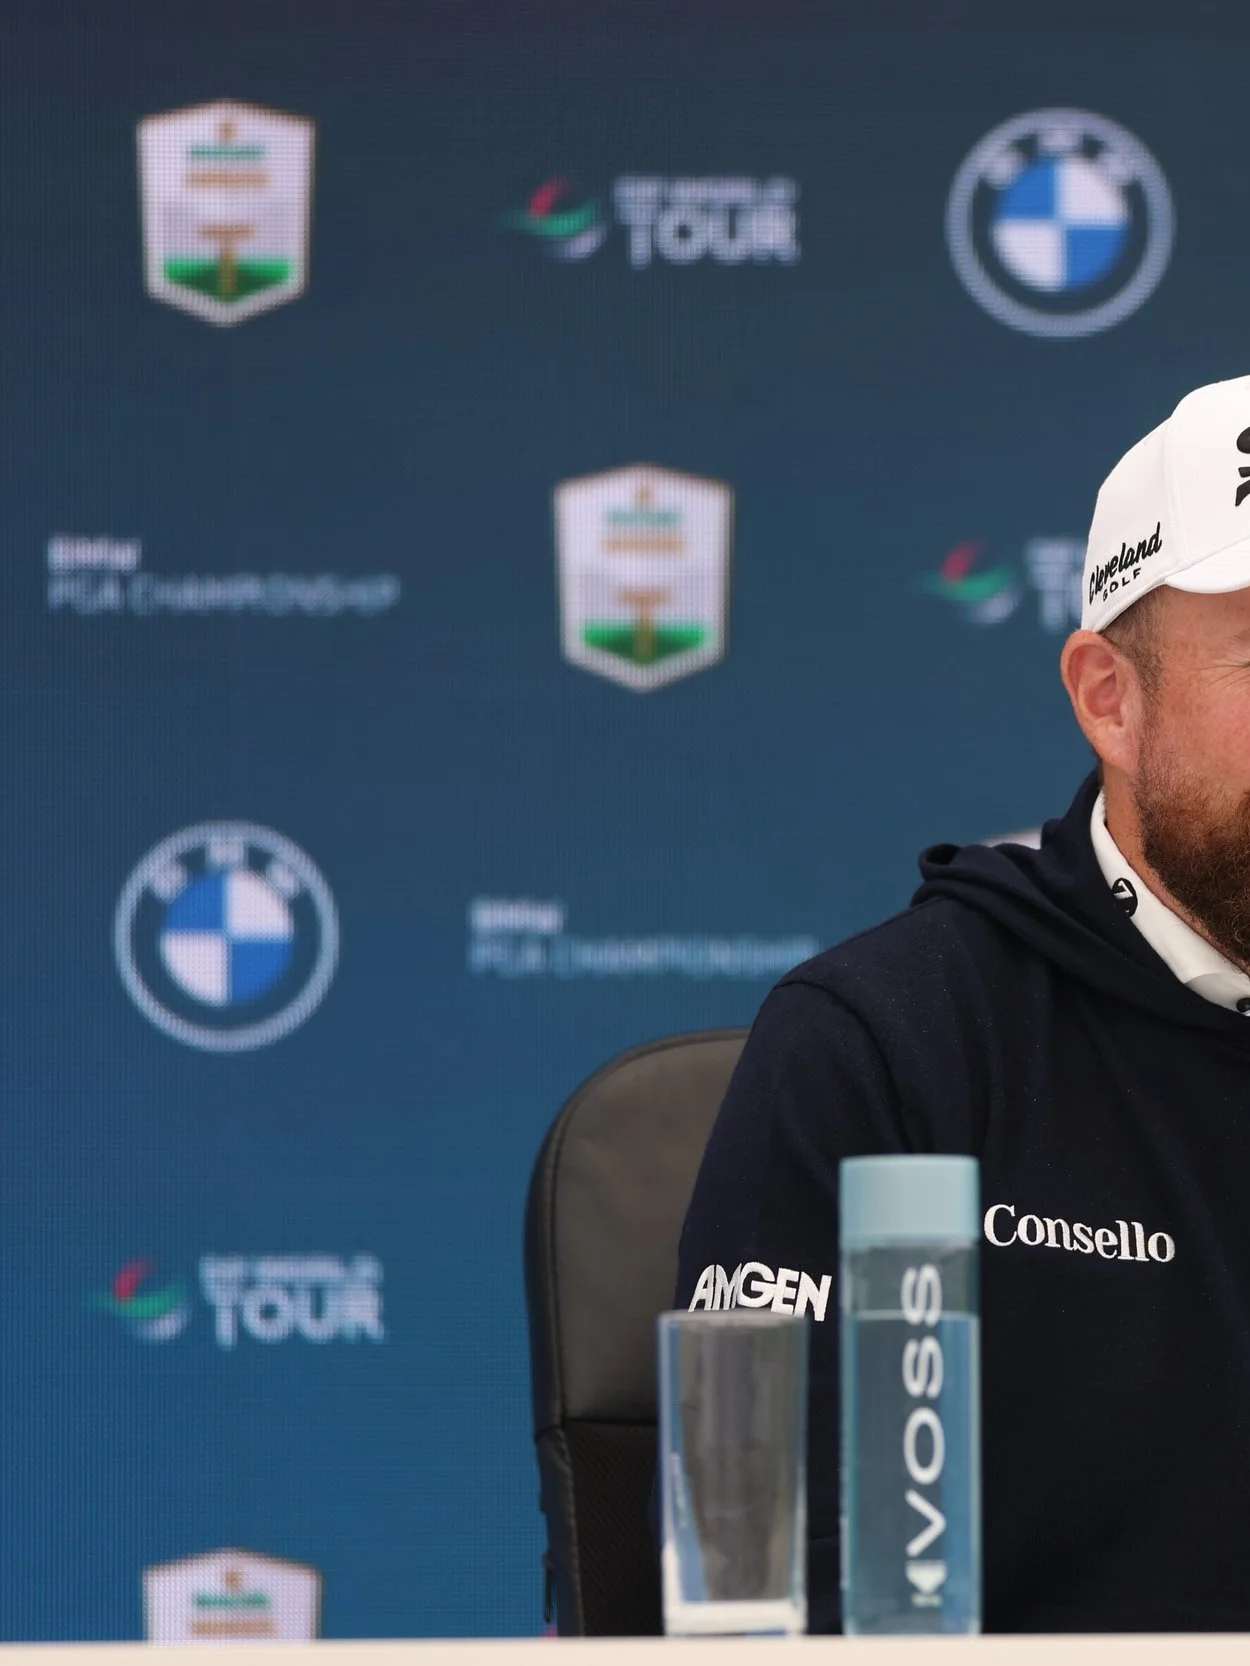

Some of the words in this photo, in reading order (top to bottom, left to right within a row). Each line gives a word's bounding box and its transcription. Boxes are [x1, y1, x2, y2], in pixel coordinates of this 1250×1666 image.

[618, 206, 800, 267] TOUR
[1089, 521, 1162, 605] Cleveland
[1103, 568, 1141, 602] GOLF
[984, 1204, 1175, 1263] Consello
[205, 1288, 385, 1348] TOUR
[688, 1261, 832, 1321] AMGEN
[902, 1264, 947, 1556] VOSS
